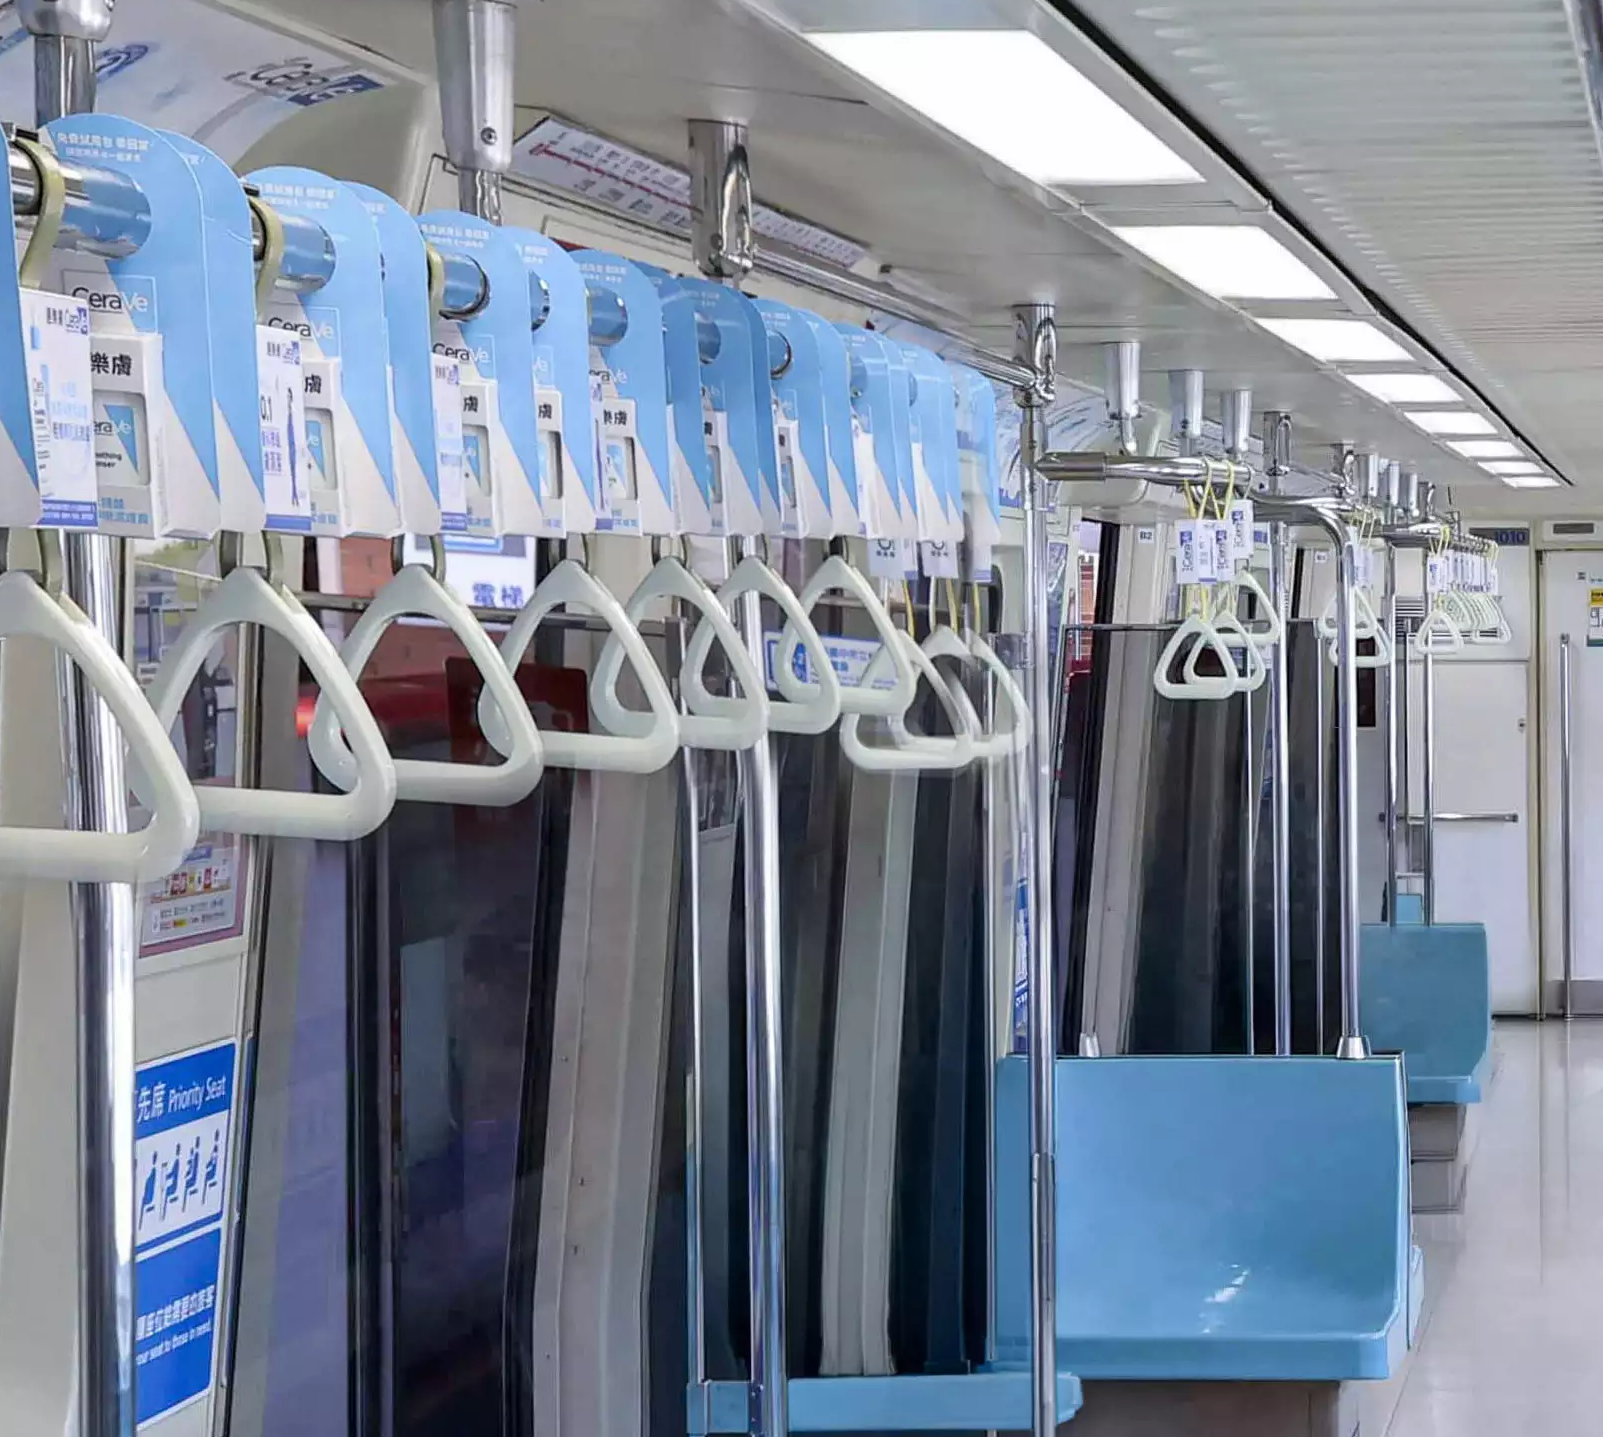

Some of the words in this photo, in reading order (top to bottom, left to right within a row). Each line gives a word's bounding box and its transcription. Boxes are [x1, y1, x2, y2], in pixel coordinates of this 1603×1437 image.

[90, 352, 133, 377] 樂膚
[136, 1081, 167, 1124] 先席
[167, 1081, 205, 1113] Priority
[205, 1075, 227, 1102] Seat
